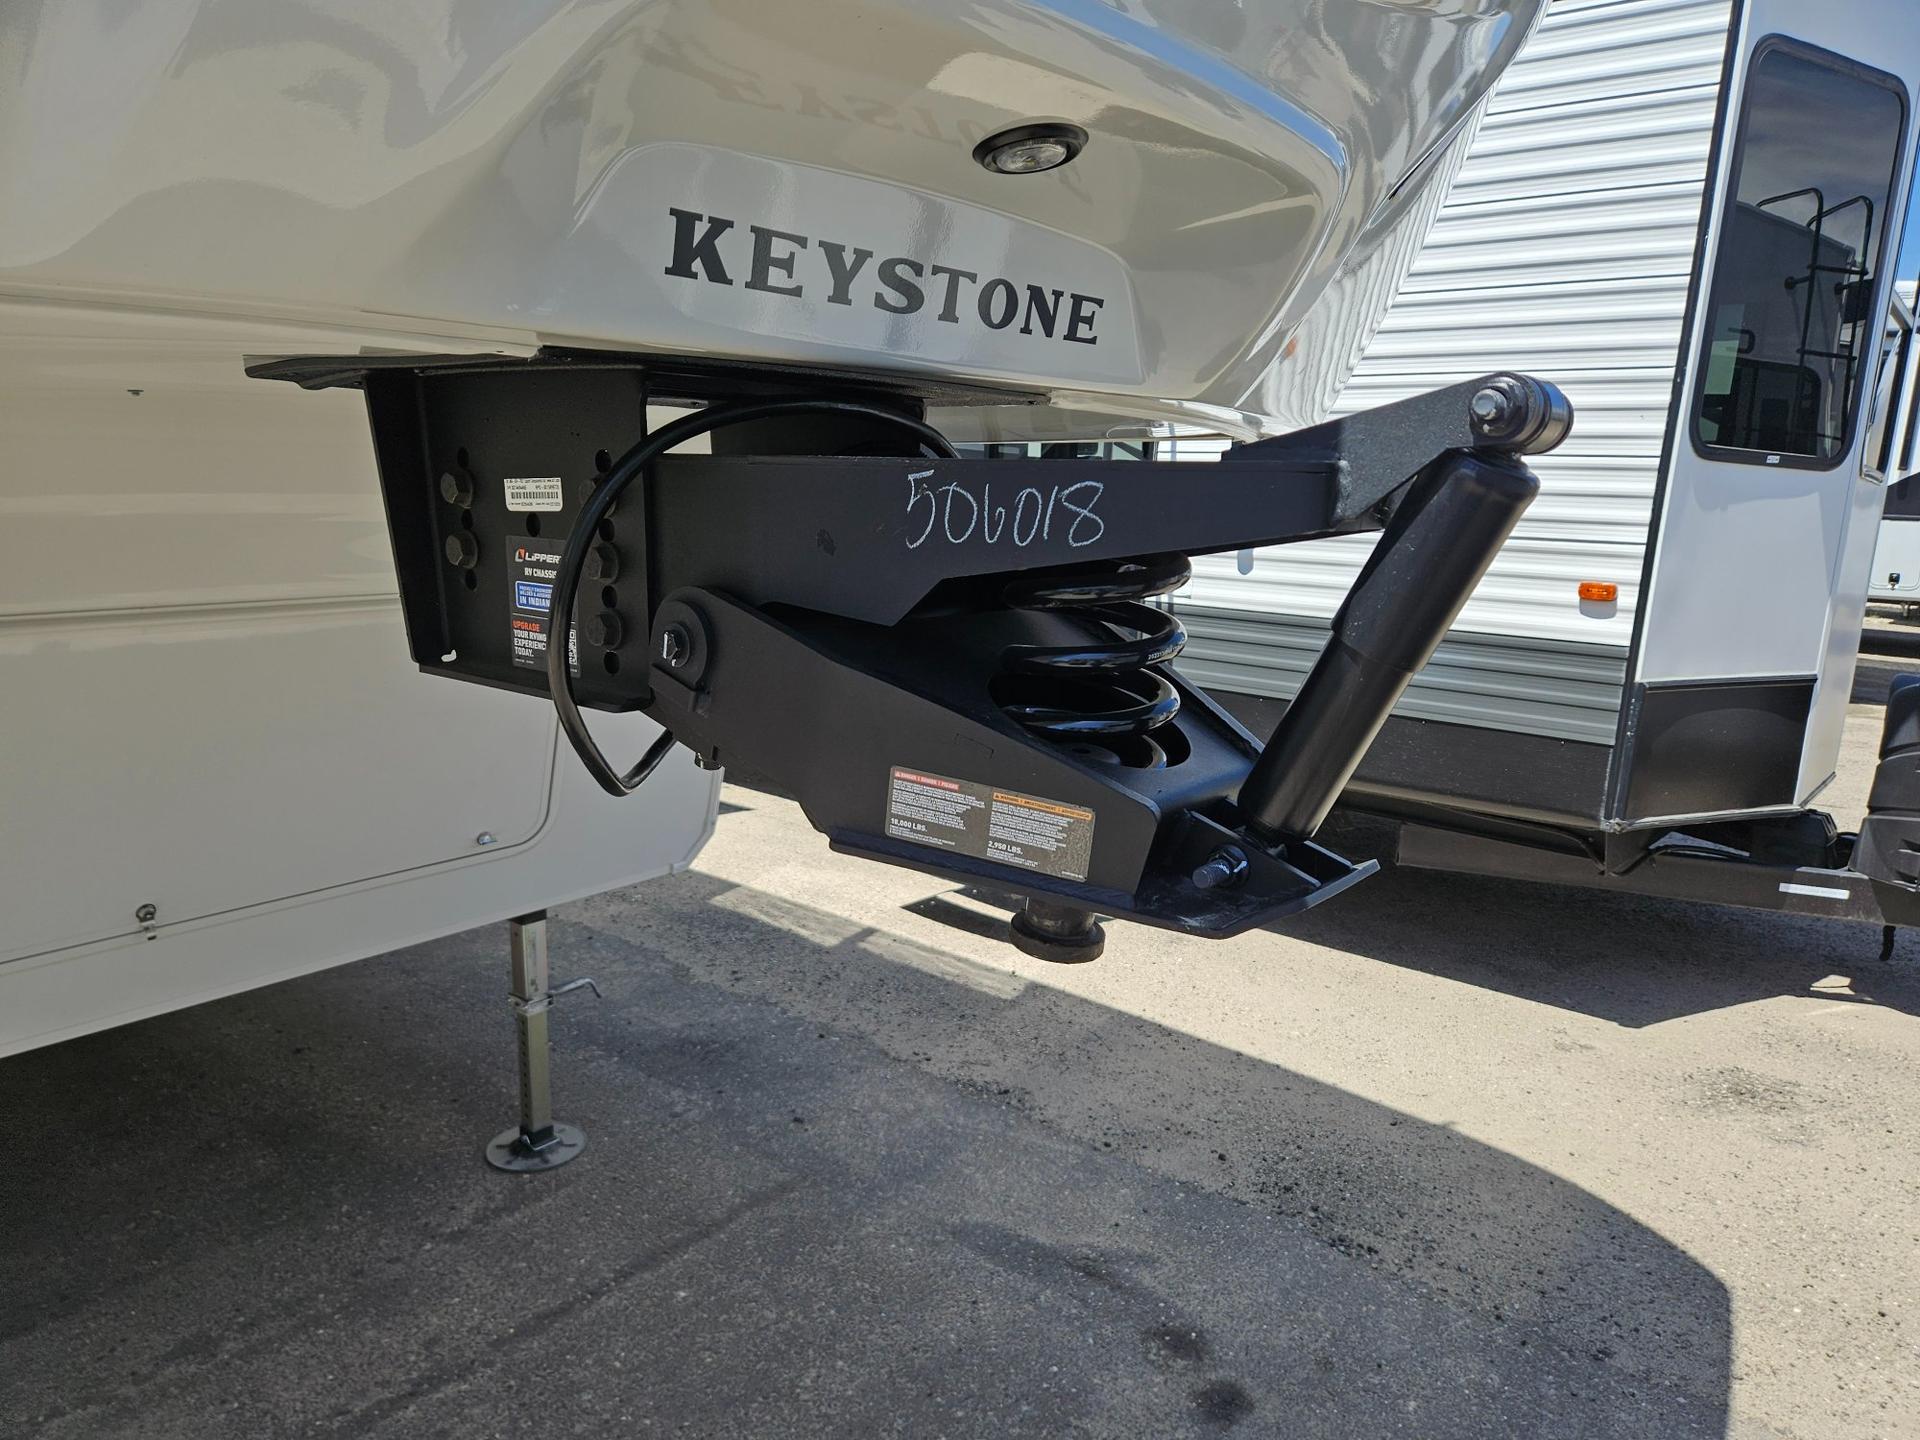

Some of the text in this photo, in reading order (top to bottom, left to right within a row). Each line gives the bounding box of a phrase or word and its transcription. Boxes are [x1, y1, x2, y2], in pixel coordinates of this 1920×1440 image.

[664, 207, 1105, 345] KEYSTONE
[905, 469, 1105, 548] 506018
[525, 552, 562, 564] LiPPER
[525, 567, 532, 576] RV
[528, 596, 551, 608] INDIAN
[513, 620, 541, 632] UPGRADE
[513, 629, 529, 639] YOUR
[514, 638, 547, 650] EXPERIENC
[514, 647, 534, 657] TODAY.
